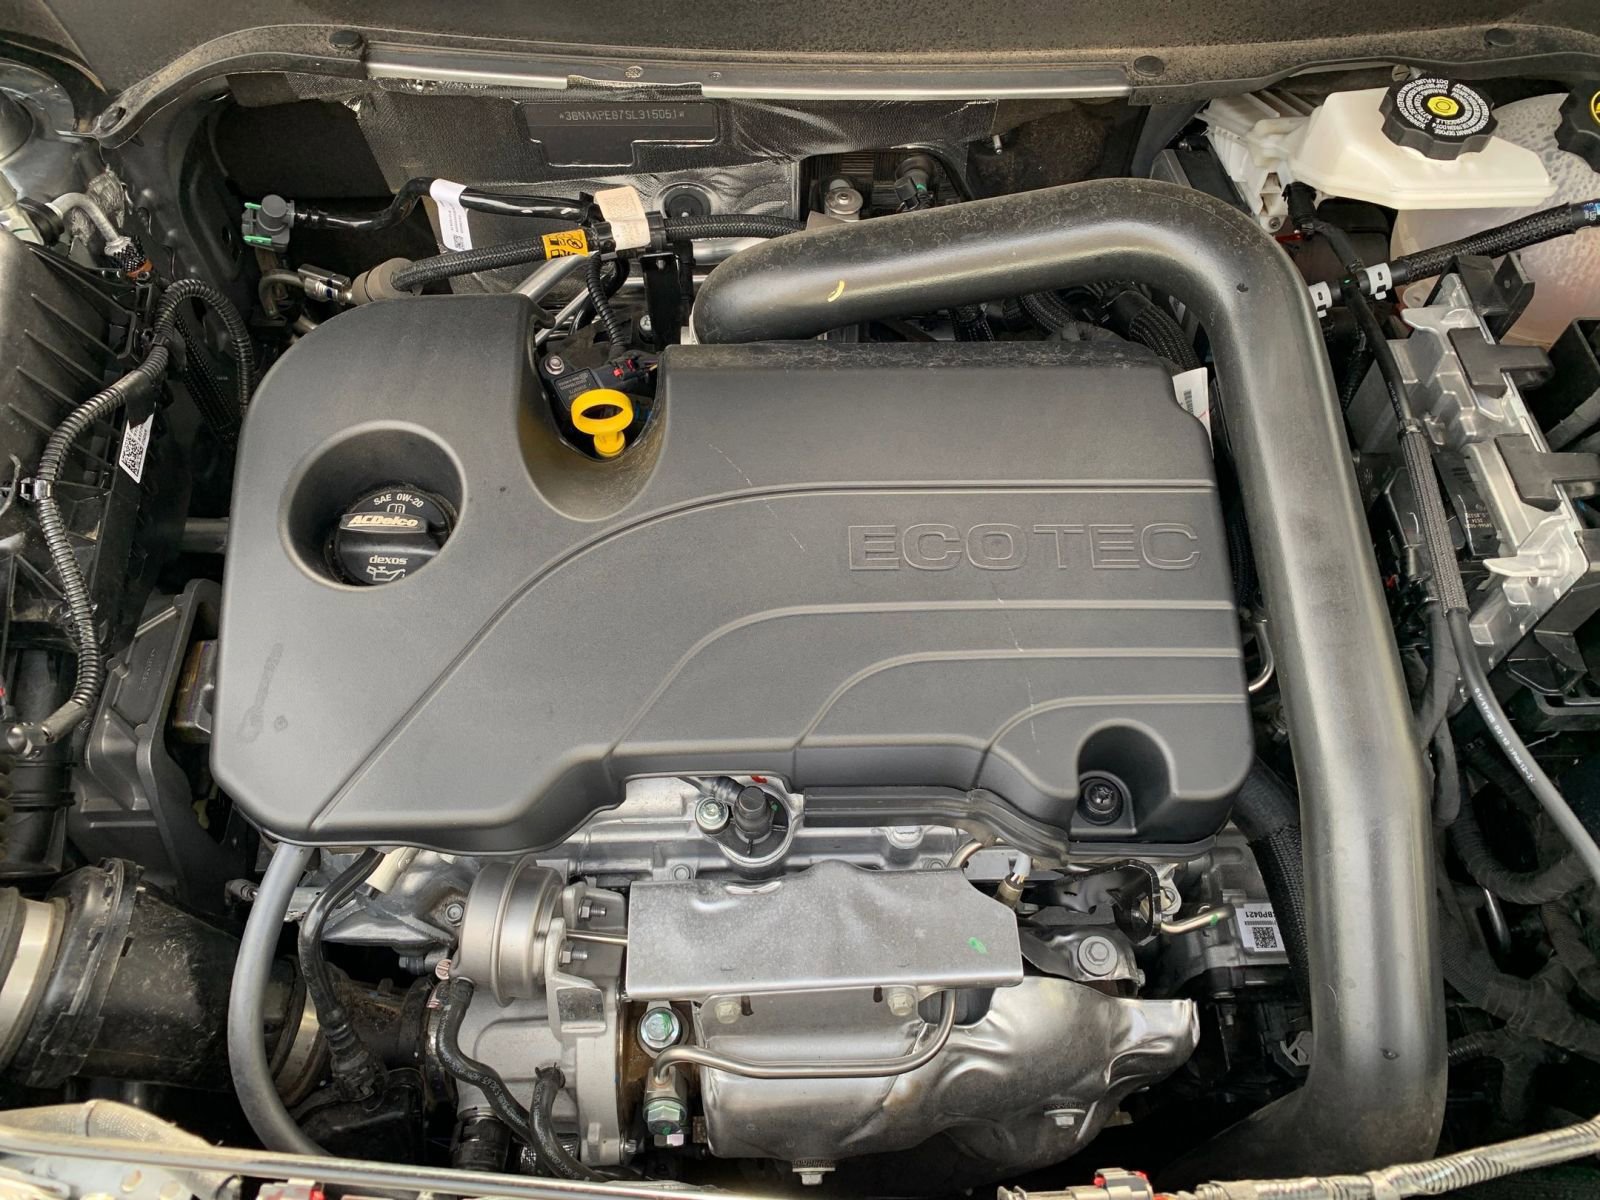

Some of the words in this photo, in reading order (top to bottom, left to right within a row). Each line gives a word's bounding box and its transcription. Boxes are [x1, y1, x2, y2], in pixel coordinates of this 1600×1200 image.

[373, 494, 392, 505] SAE
[396, 493, 424, 508] 0W-20
[347, 515, 418, 528] ACDelco
[848, 523, 1200, 570] ECOTEC
[369, 555, 408, 565] dexos
